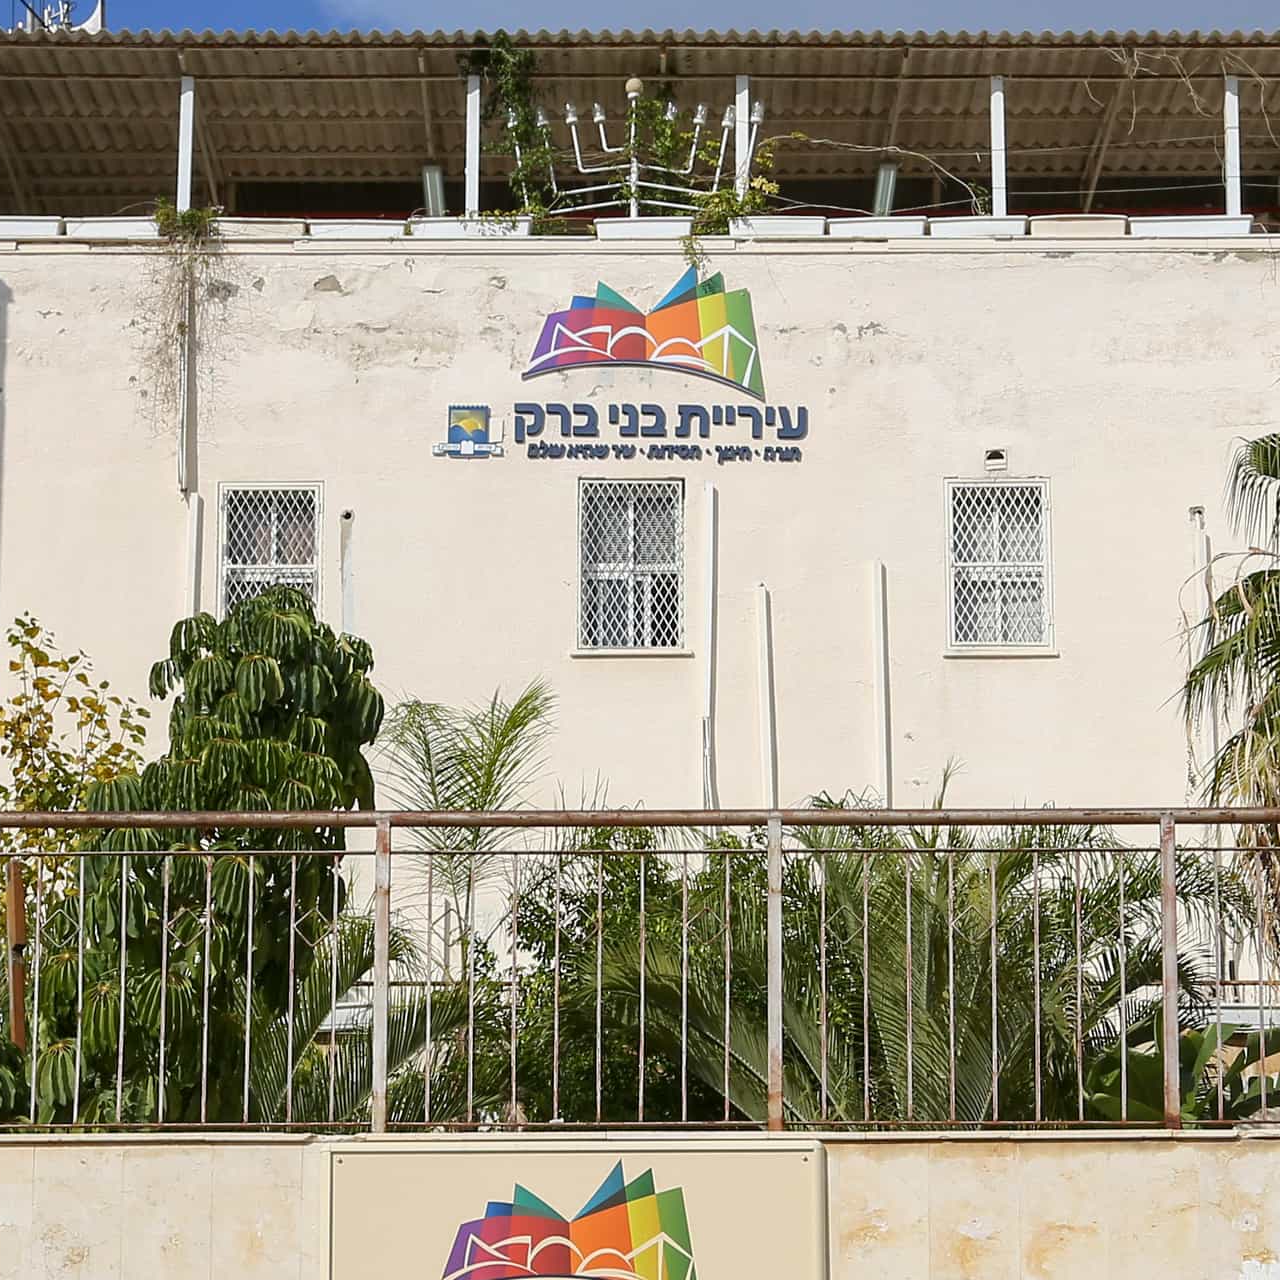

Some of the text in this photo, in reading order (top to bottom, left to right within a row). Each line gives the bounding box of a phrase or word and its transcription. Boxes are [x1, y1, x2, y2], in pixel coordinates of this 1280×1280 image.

[514, 402, 809, 444] עיריית בני ברק
